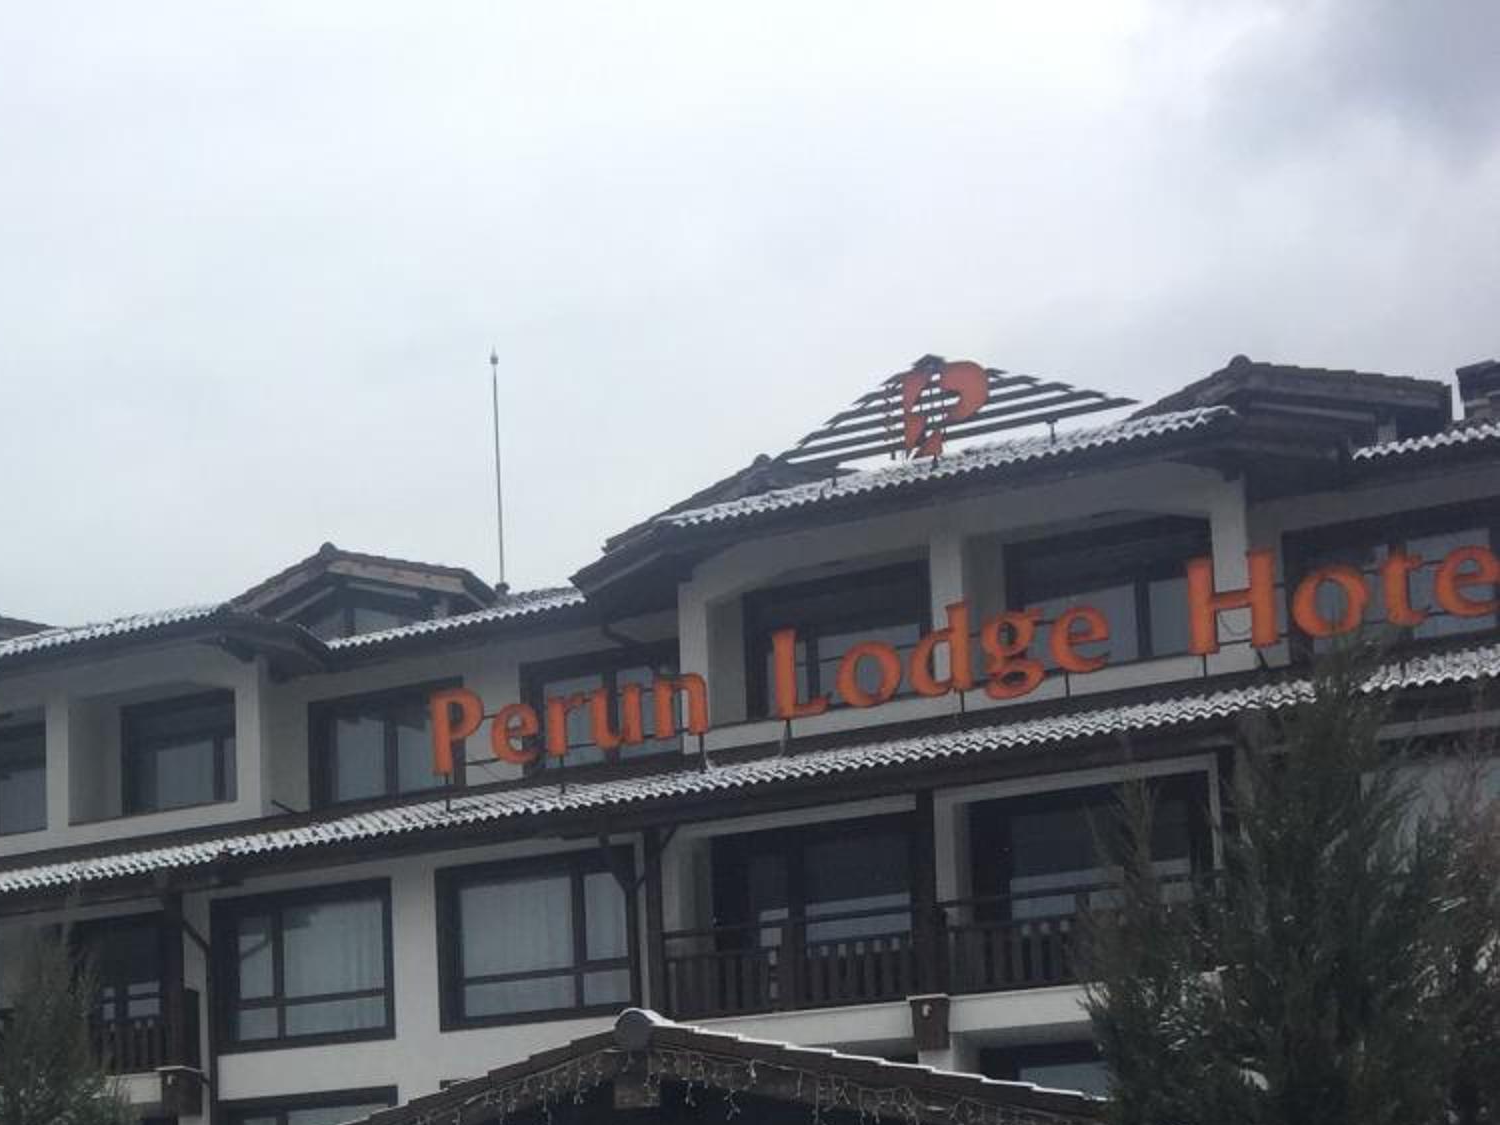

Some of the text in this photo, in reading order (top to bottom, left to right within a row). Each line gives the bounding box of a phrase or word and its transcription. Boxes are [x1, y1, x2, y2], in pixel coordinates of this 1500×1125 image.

[430, 547, 1500, 775] Perun Lodge Hote
